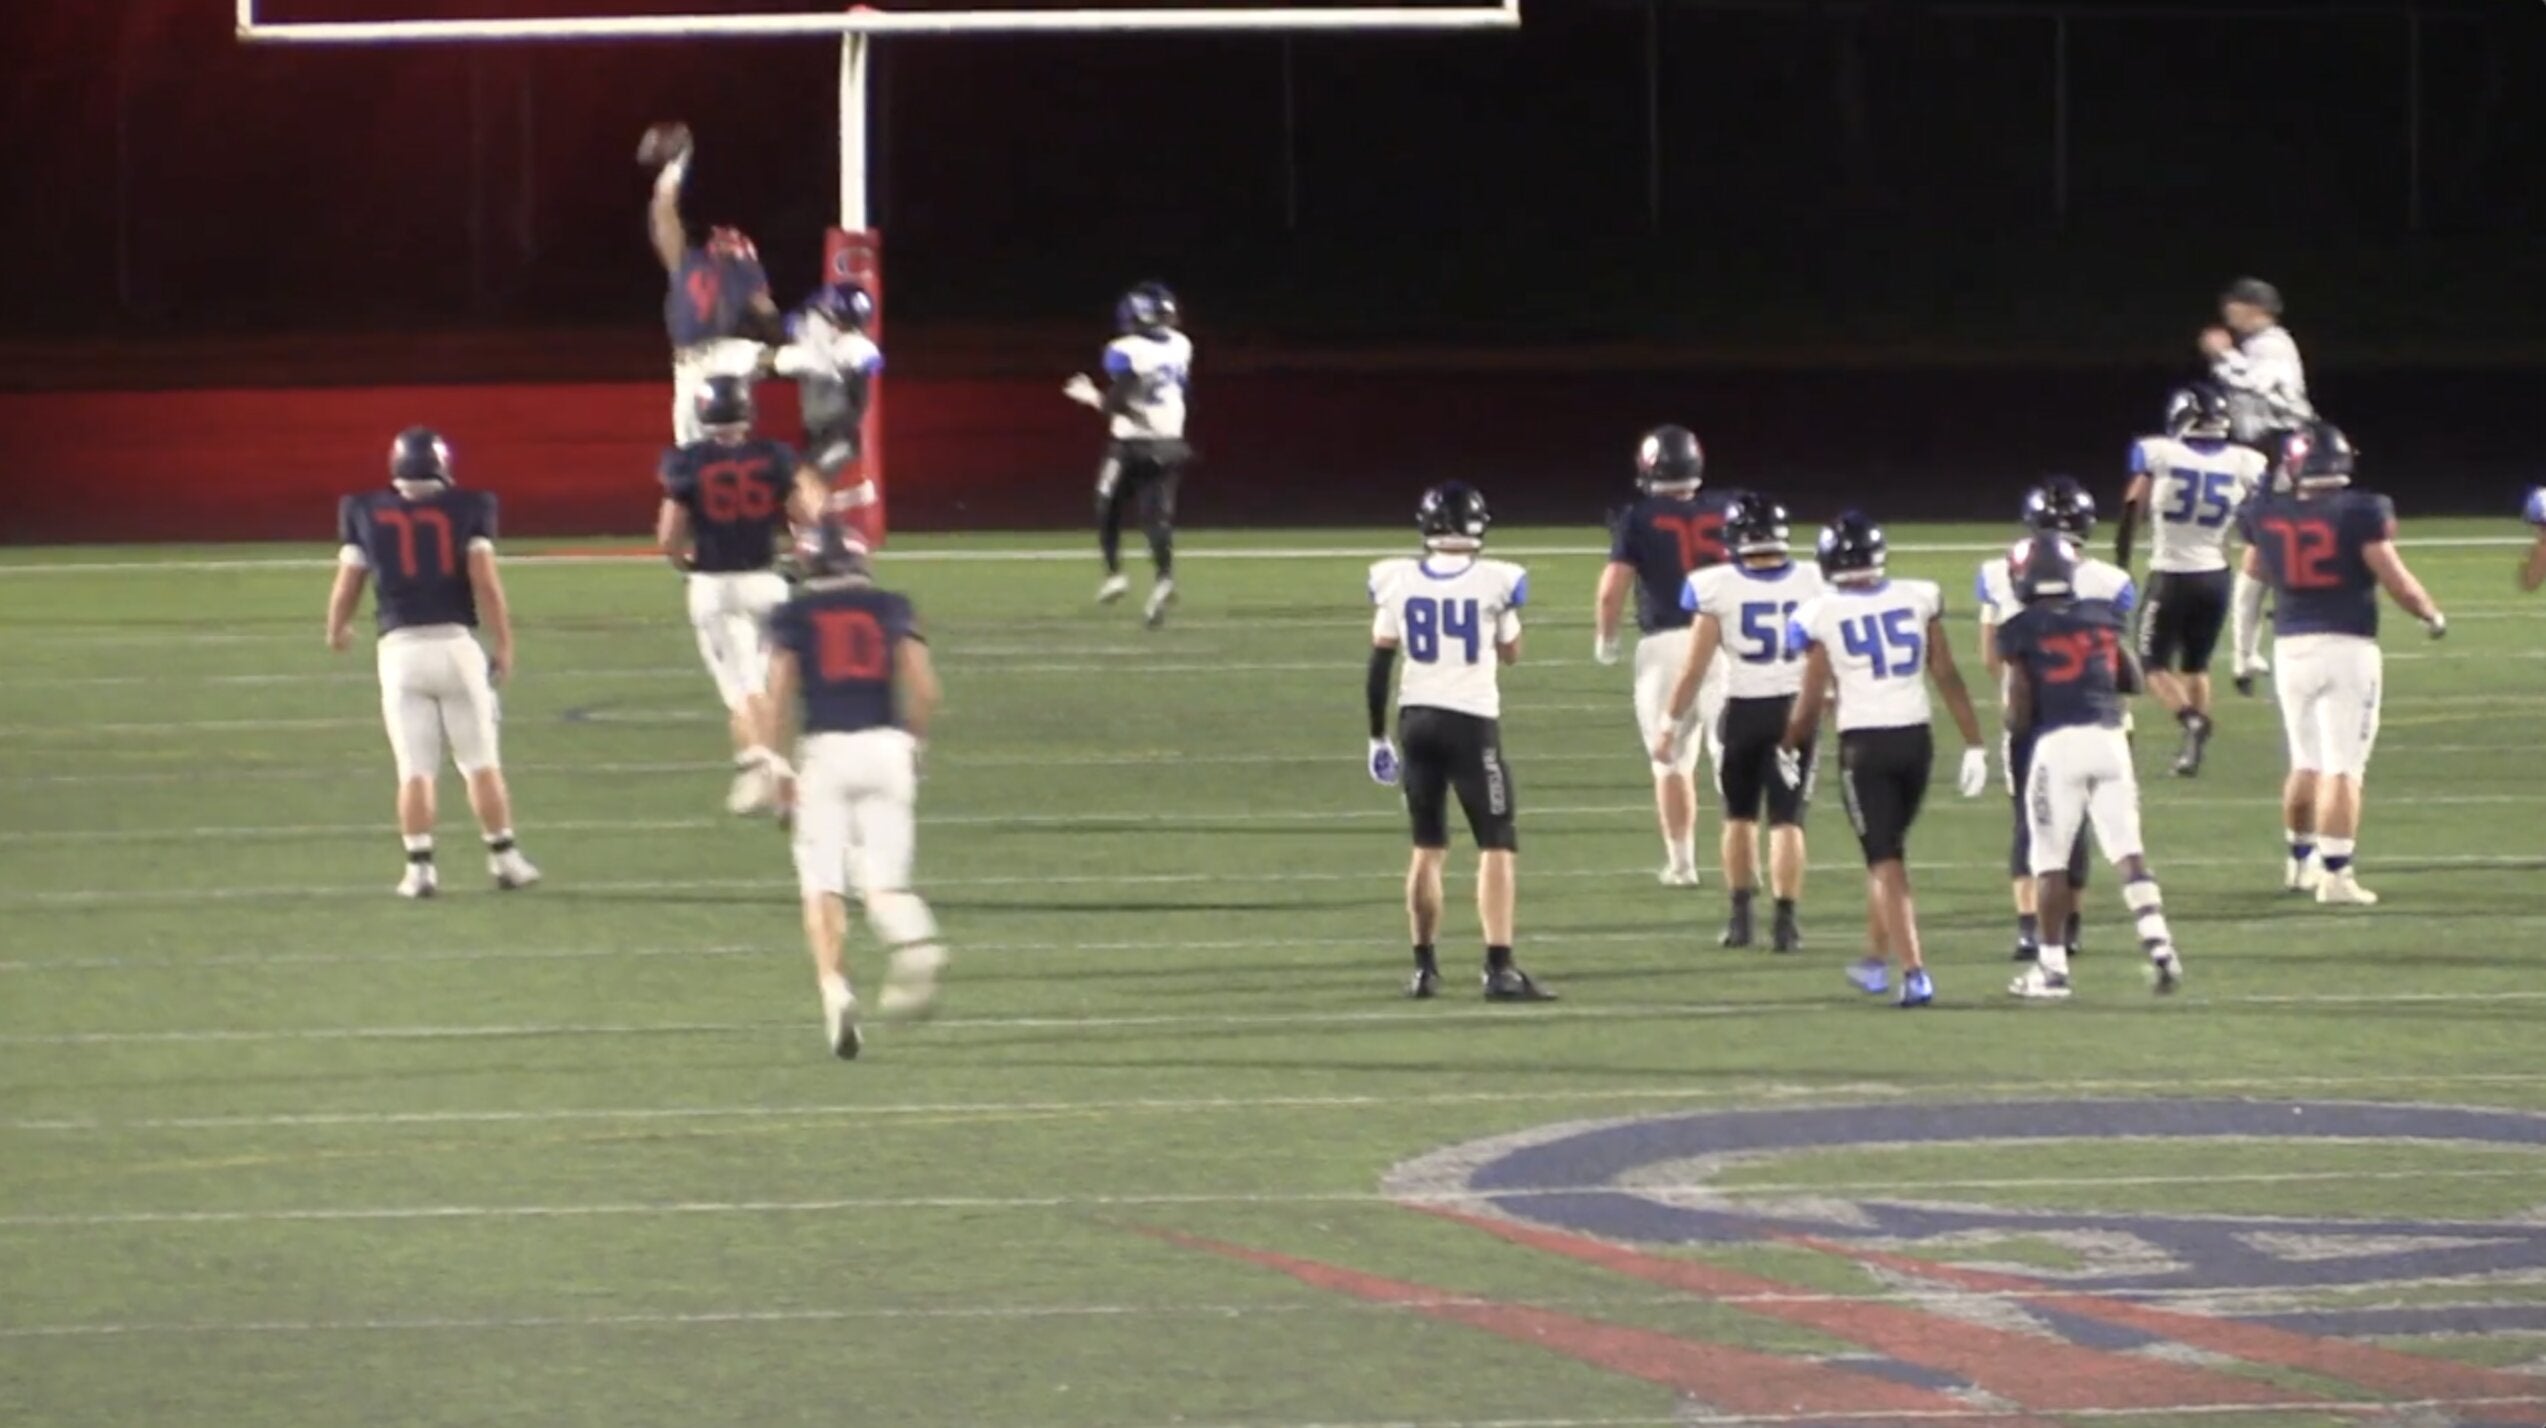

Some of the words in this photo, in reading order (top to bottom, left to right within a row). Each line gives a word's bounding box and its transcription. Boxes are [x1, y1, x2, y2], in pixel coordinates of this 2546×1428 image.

[2162, 467, 2235, 528] 35
[373, 506, 454, 577] 77
[2262, 520, 2341, 588] 72
[1404, 597, 1480, 664] 84
[1839, 606, 1922, 680] 45
